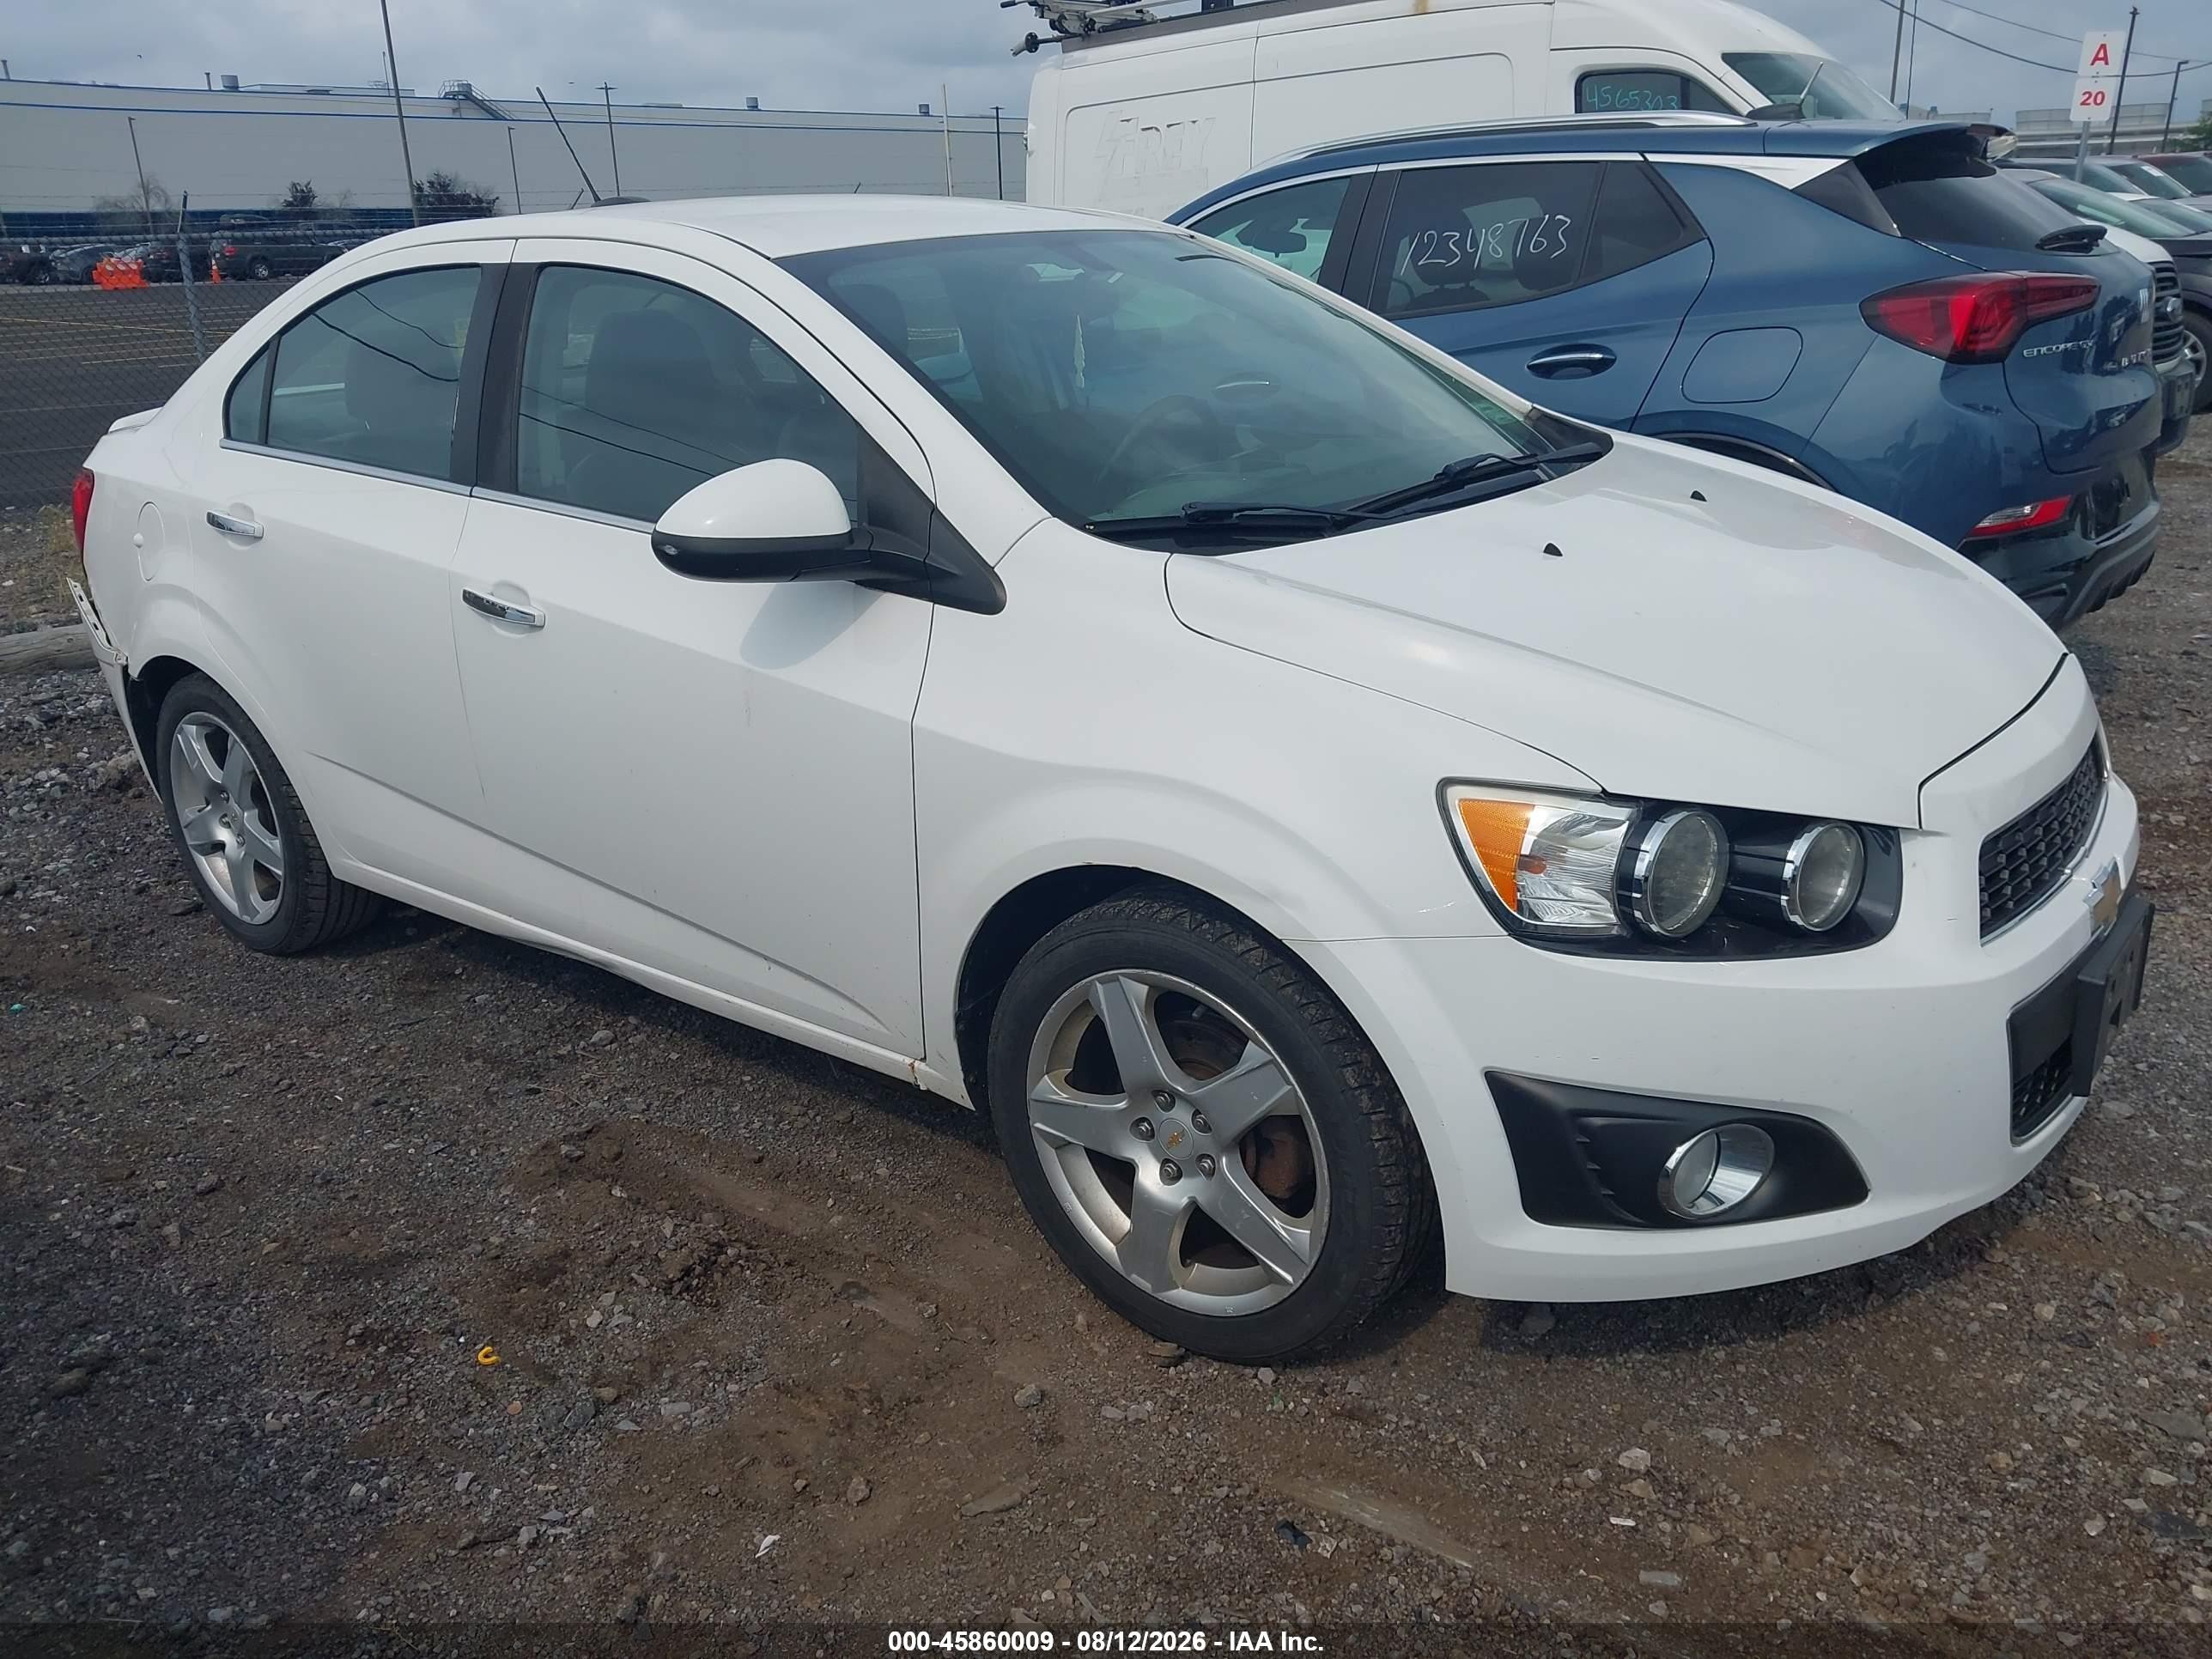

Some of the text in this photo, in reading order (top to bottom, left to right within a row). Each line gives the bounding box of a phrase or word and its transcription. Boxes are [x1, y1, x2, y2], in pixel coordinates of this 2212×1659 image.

[2090, 43, 2110, 66] A
[2080, 90, 2106, 106] 20
[1401, 214, 1571, 276] 12348763
